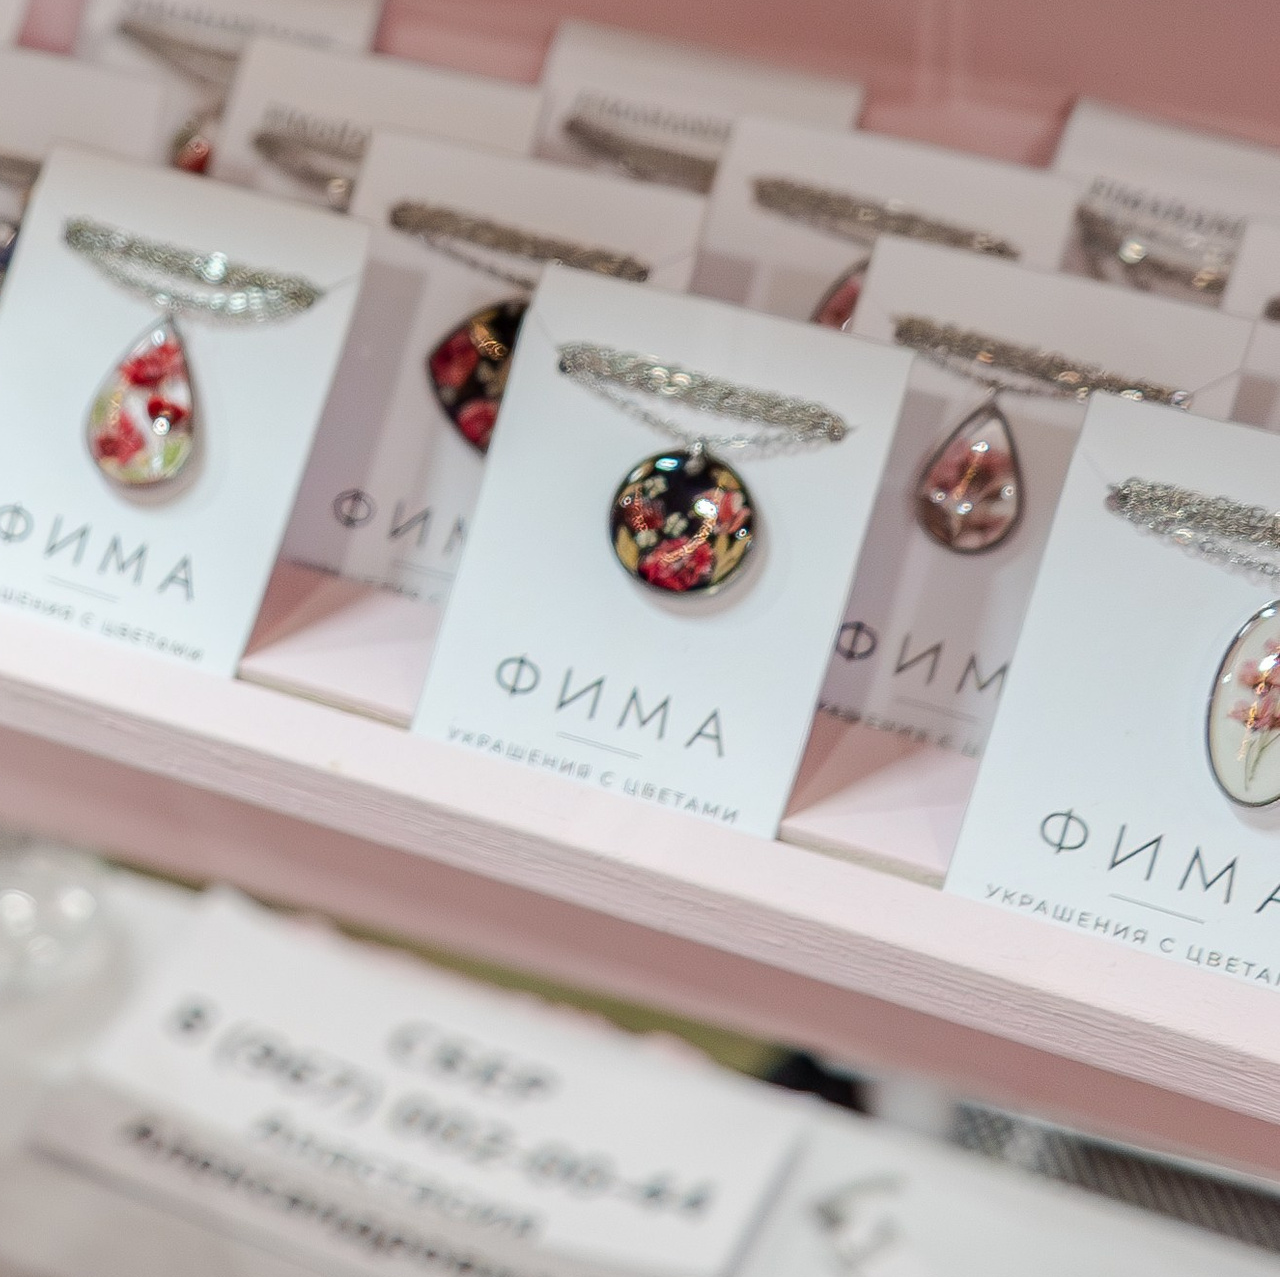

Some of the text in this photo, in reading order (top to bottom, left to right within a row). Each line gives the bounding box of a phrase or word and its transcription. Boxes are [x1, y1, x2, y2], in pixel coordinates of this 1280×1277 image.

[494, 652, 726, 759] ФИМА
[985, 882, 1149, 944] УКРАШЕНИЯ
[1159, 936, 1176, 955] С
